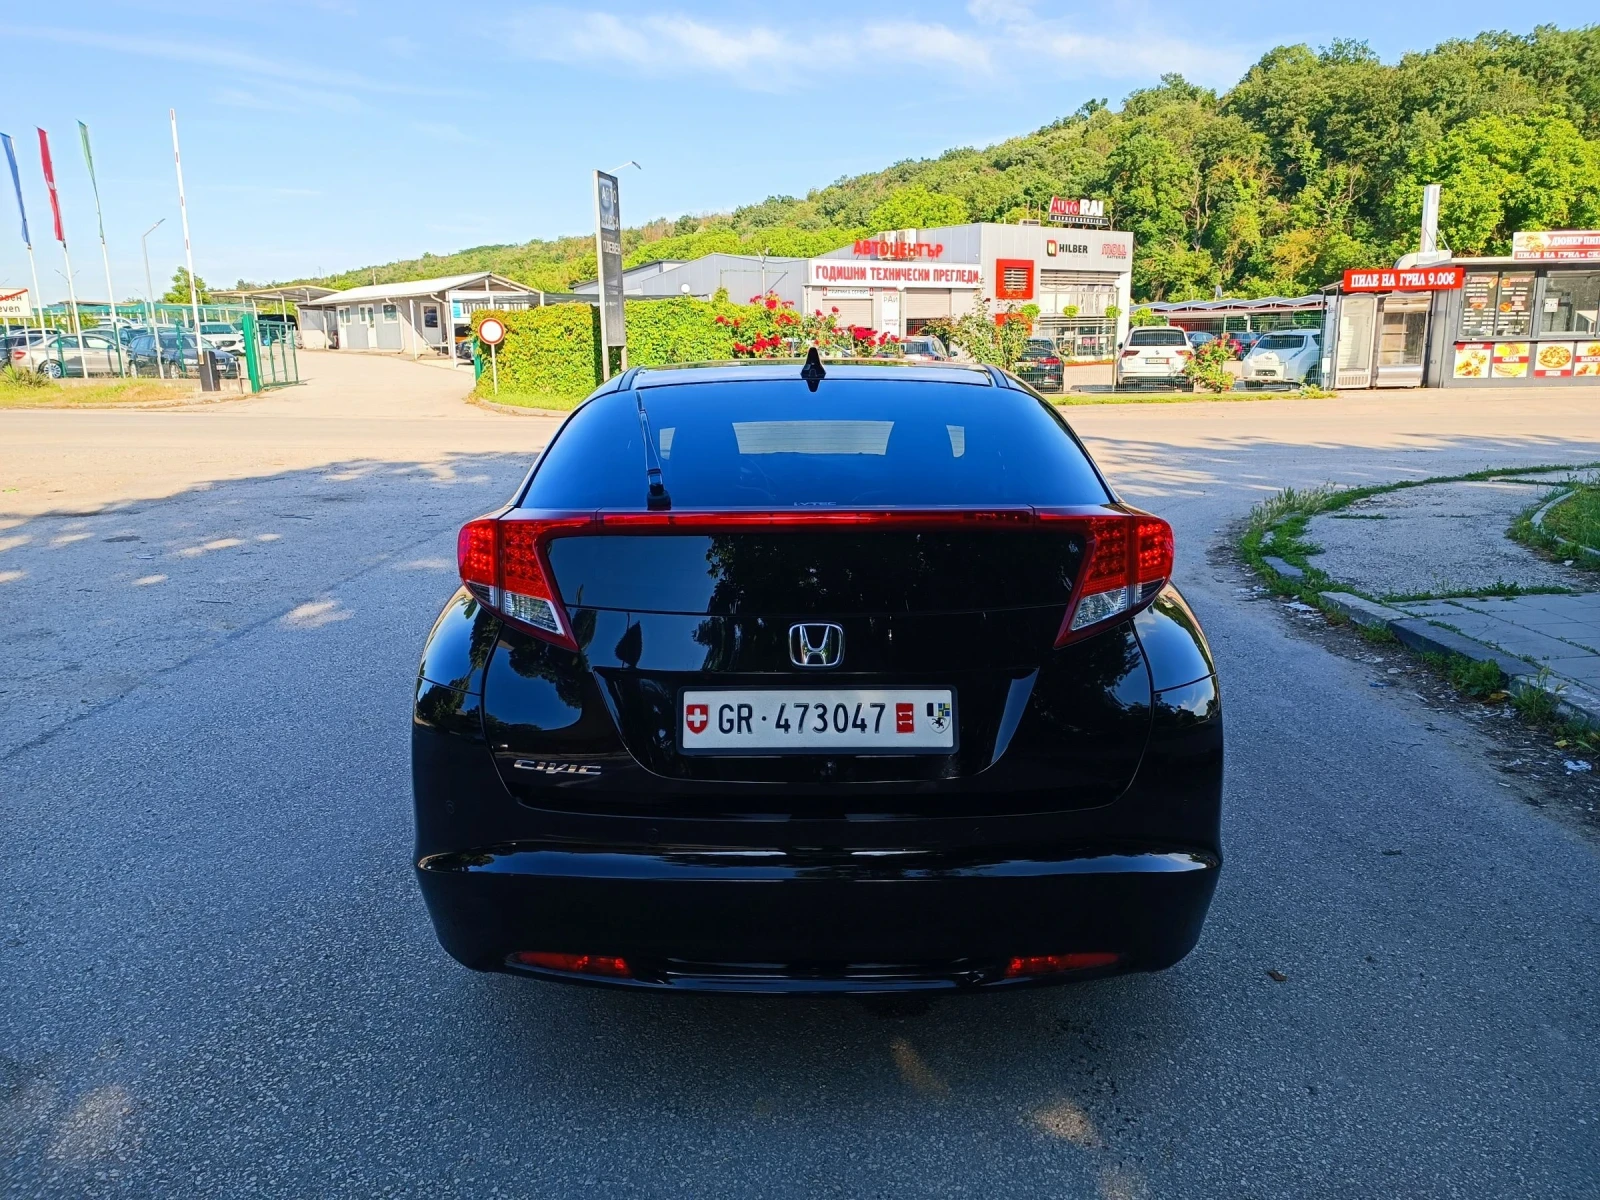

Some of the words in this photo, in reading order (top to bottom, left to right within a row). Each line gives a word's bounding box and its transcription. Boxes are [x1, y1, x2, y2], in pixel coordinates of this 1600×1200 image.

[853, 239, 943, 259] АВТОЦЕНТЪР
[1059, 244, 1088, 254] HILBER
[1517, 251, 1541, 259] ПИЛЕ
[815, 265, 867, 281] ГОДИШНИ
[870, 267, 931, 282] ТЕХНИЧЕСКИ
[933, 268, 979, 284] ПРЕГЛЕДИ
[1351, 274, 1379, 288] ПИЛЕ
[1381, 273, 1396, 287] НА
[1399, 272, 1425, 286] ГРИЛ
[1428, 271, 1456, 286] 9.00€
[775, 702, 886, 734] 473047
[513, 759, 602, 775] CIVIC
